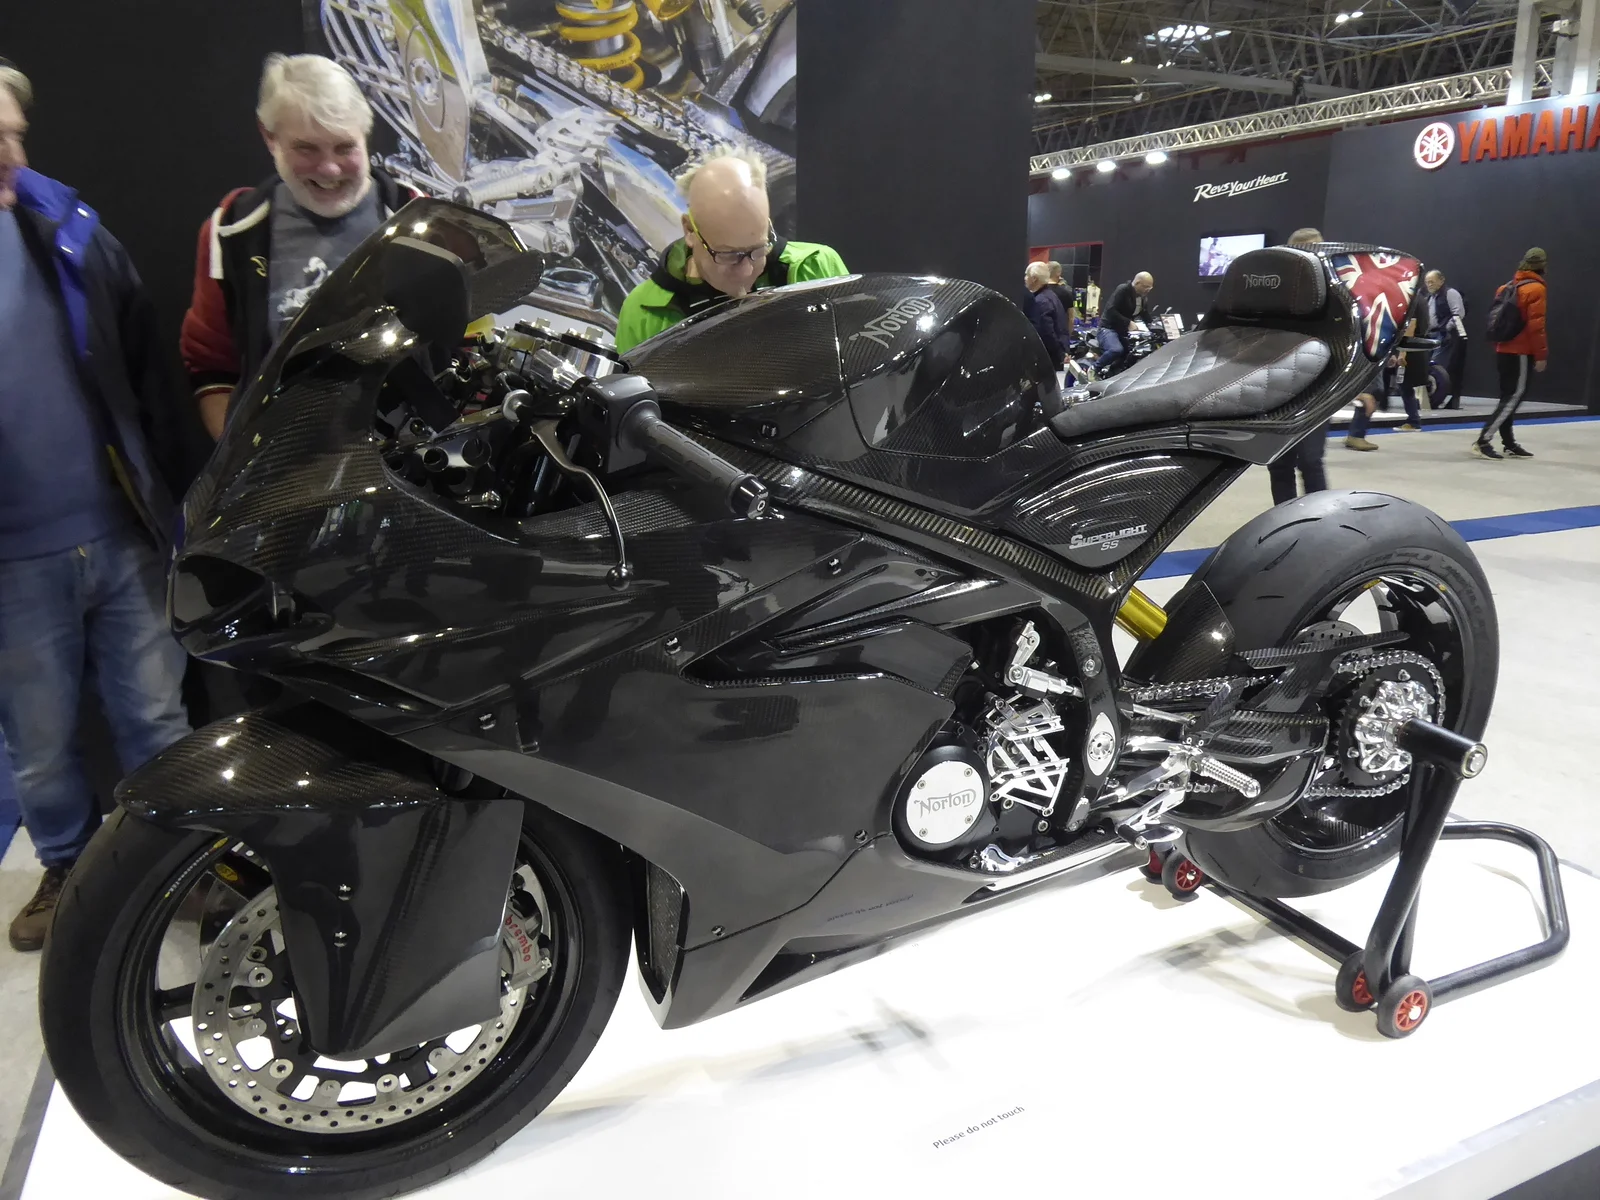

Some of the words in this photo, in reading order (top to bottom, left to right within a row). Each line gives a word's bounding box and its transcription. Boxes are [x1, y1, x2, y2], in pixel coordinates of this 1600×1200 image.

[1242, 273, 1282, 290] Norton
[848, 296, 935, 349] Norton
[1100, 540, 1119, 551] SS
[913, 788, 977, 818] Norton
[504, 914, 533, 962] brembo
[932, 1130, 966, 1149] Please
[966, 1125, 980, 1135] do
[980, 1117, 998, 1128] not
[997, 1106, 1025, 1121] touch
